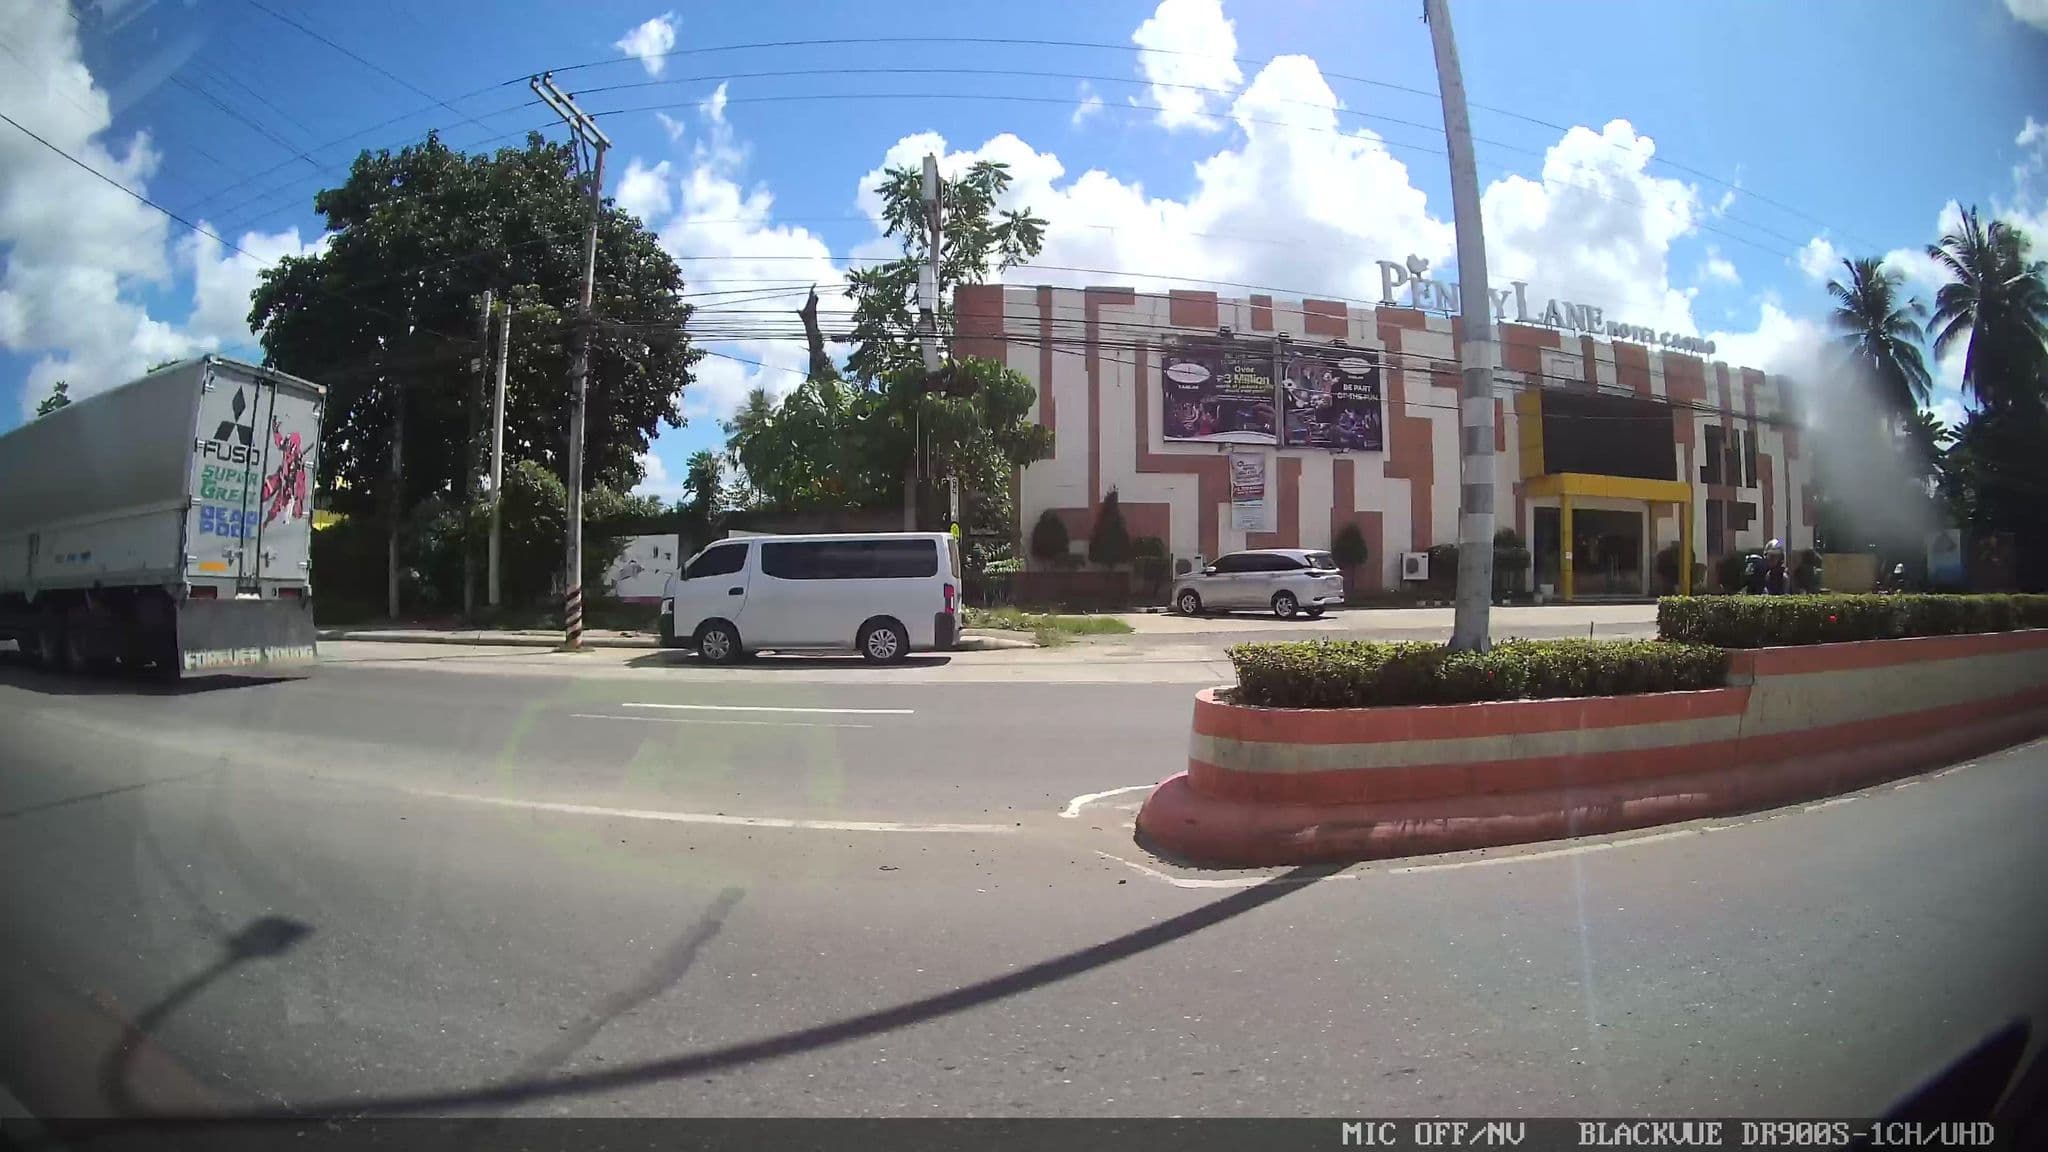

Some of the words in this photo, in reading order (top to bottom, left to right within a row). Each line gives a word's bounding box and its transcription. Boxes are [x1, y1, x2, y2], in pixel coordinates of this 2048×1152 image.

[1376, 260, 1510, 319] PENY
[1511, 281, 1604, 333] LANE
[202, 441, 260, 465] FUSO
[201, 465, 258, 486] SUPER
[201, 479, 257, 505] GRET
